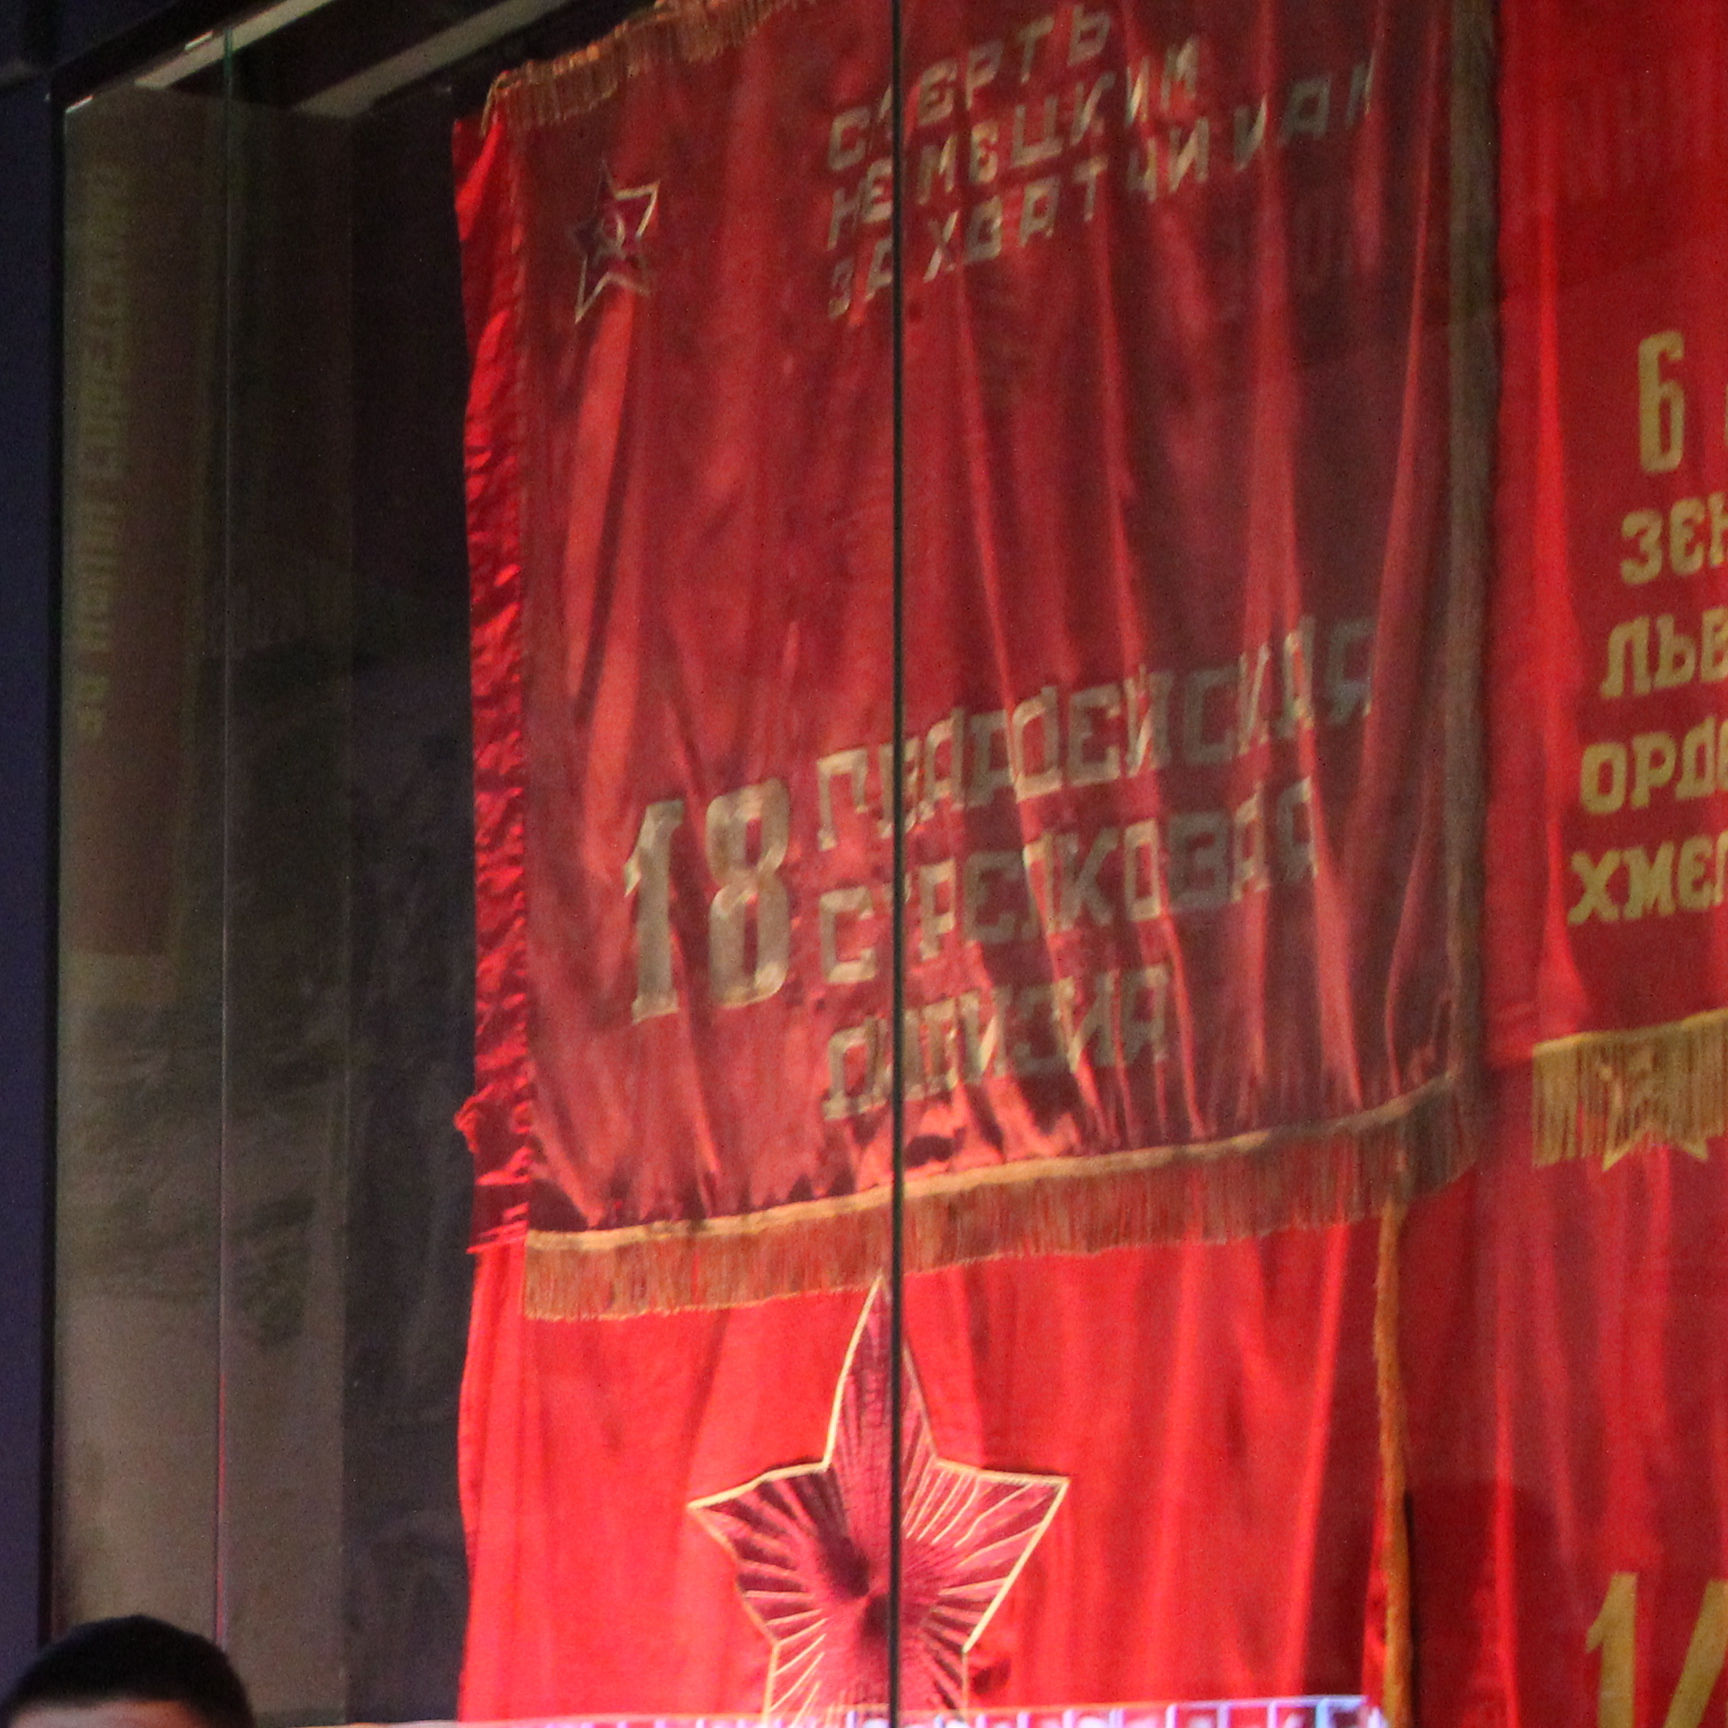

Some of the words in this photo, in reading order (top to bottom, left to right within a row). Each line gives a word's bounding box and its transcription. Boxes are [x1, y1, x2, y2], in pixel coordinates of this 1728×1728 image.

[1638, 329, 1685, 474] 6
[1579, 716, 1728, 815] ОРД
[623, 778, 791, 1025] 18
[817, 776, 1320, 986] СРЕЛКОВАЯ
